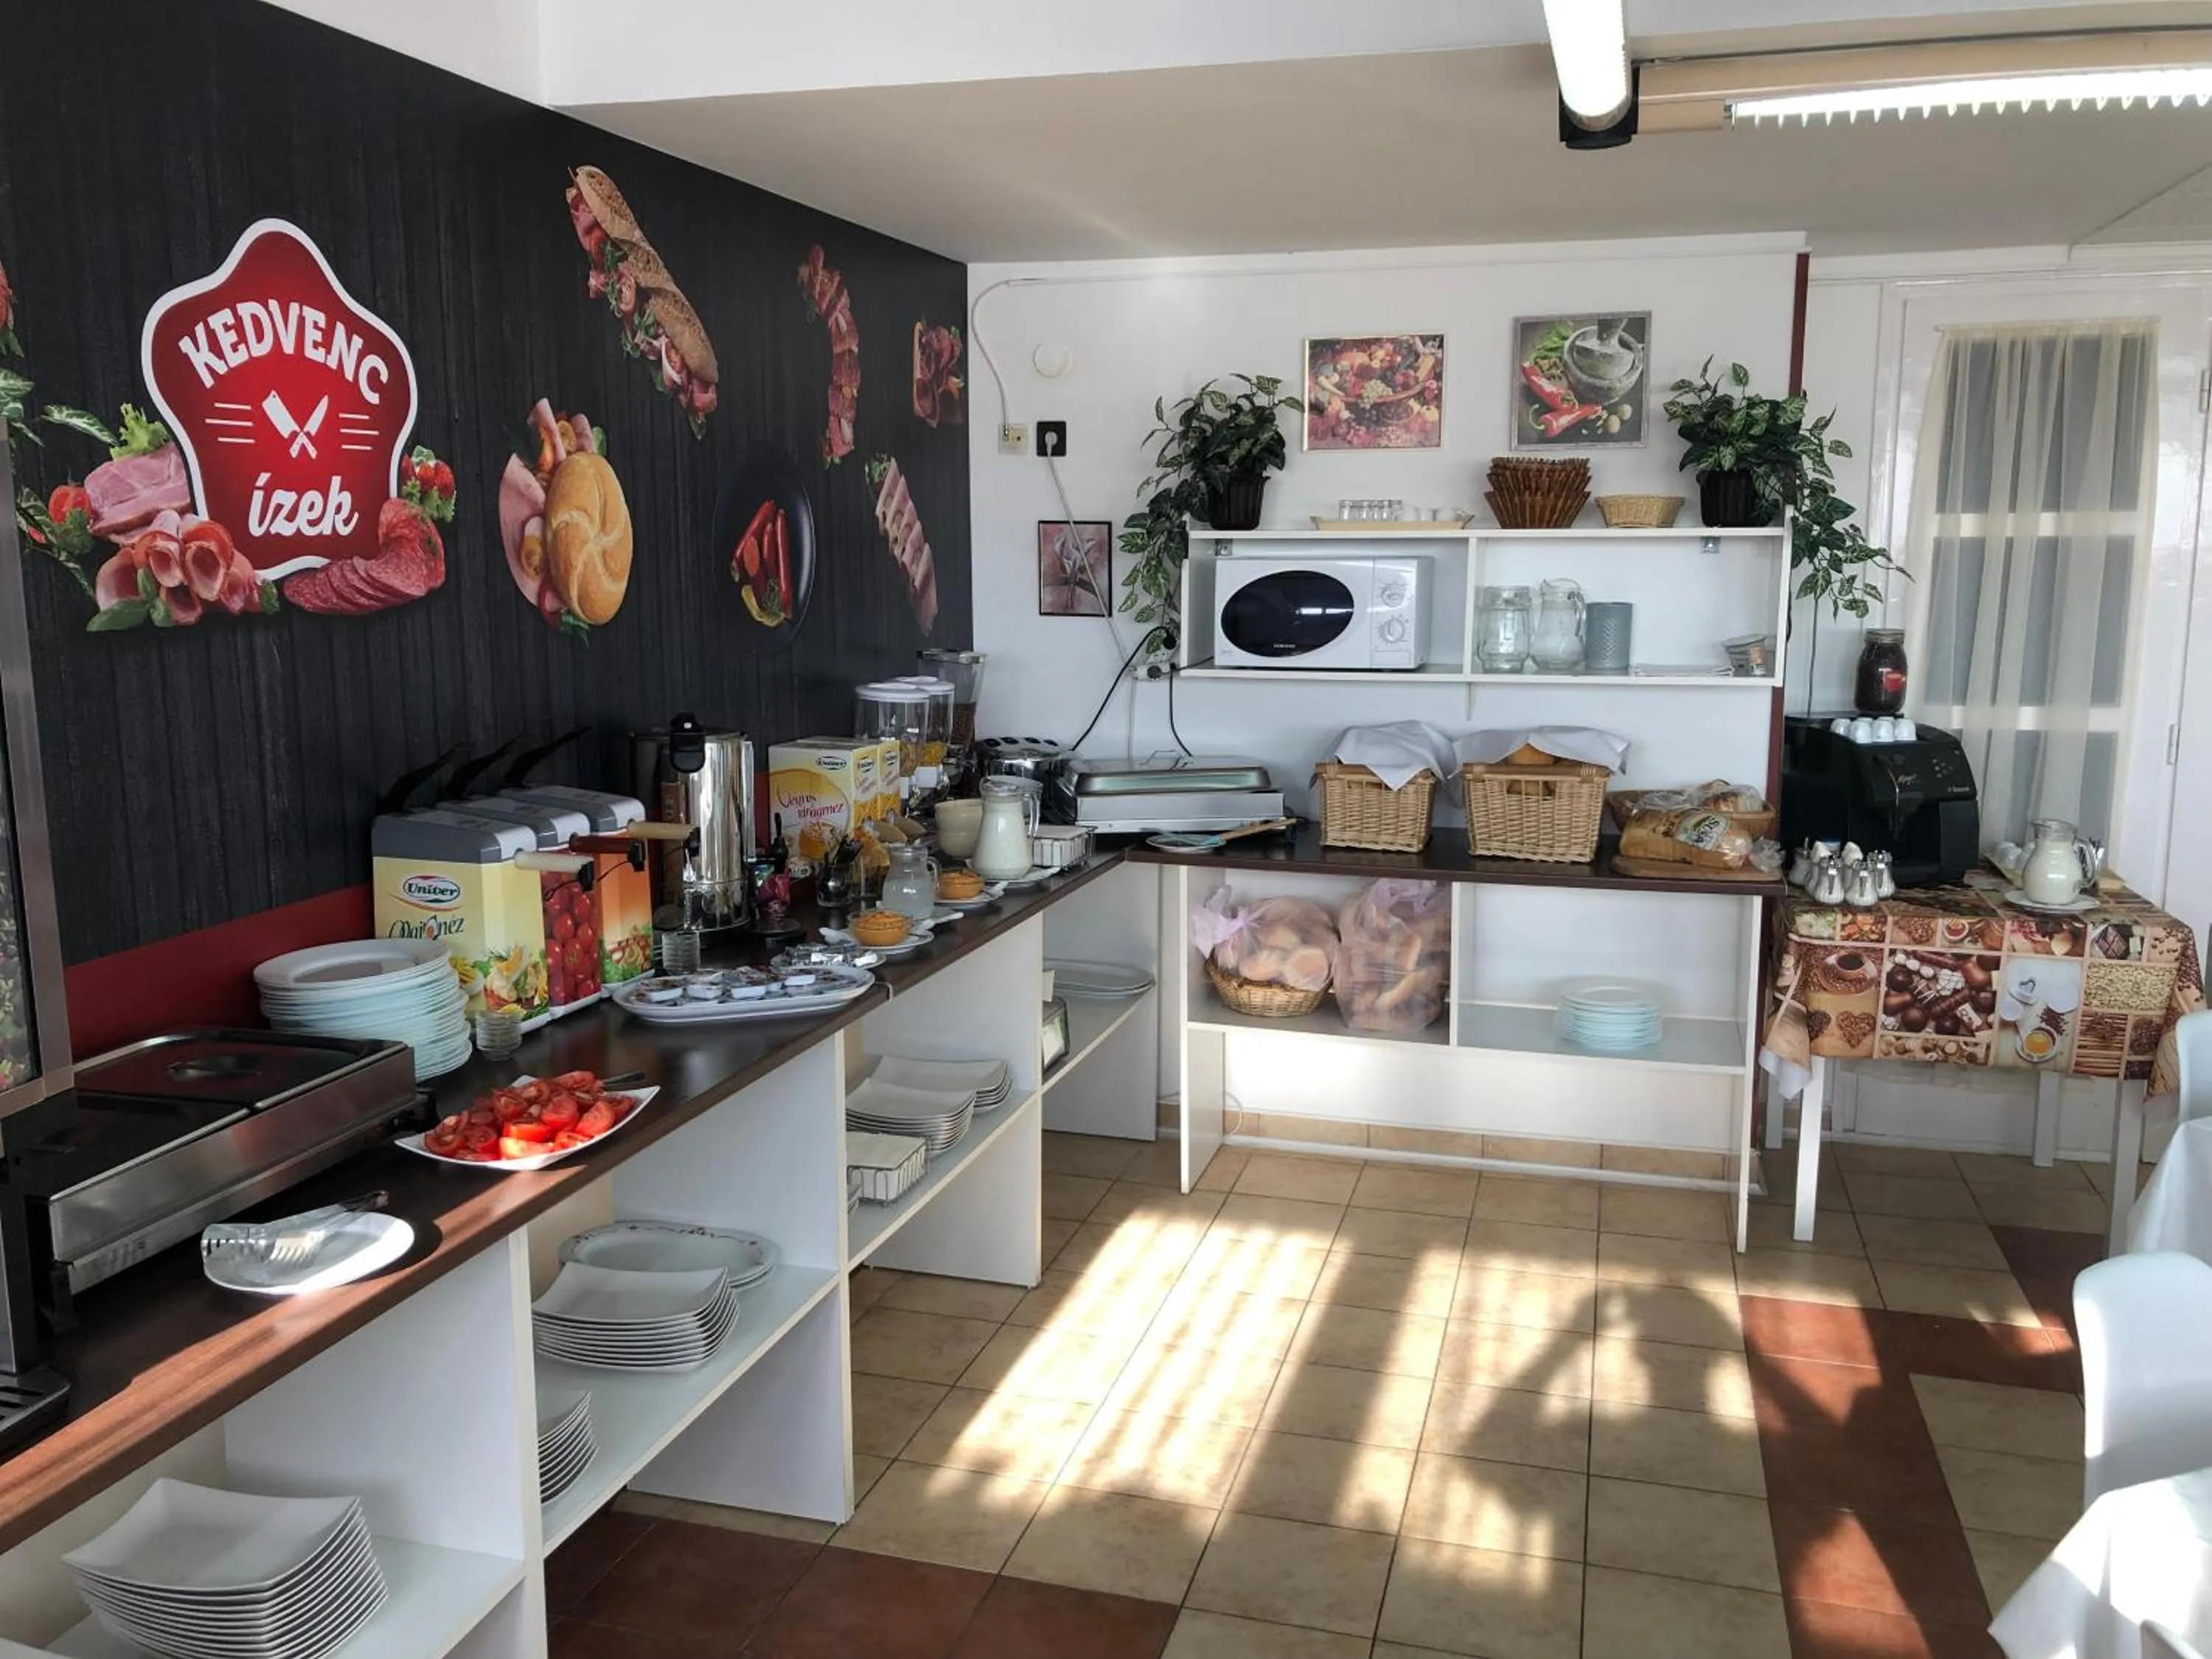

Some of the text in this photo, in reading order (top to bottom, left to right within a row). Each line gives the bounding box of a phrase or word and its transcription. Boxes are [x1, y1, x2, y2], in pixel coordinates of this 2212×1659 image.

[178, 299, 389, 405] KEDVENC
[248, 472, 358, 537] ízek
[408, 883, 458, 896] Univer
